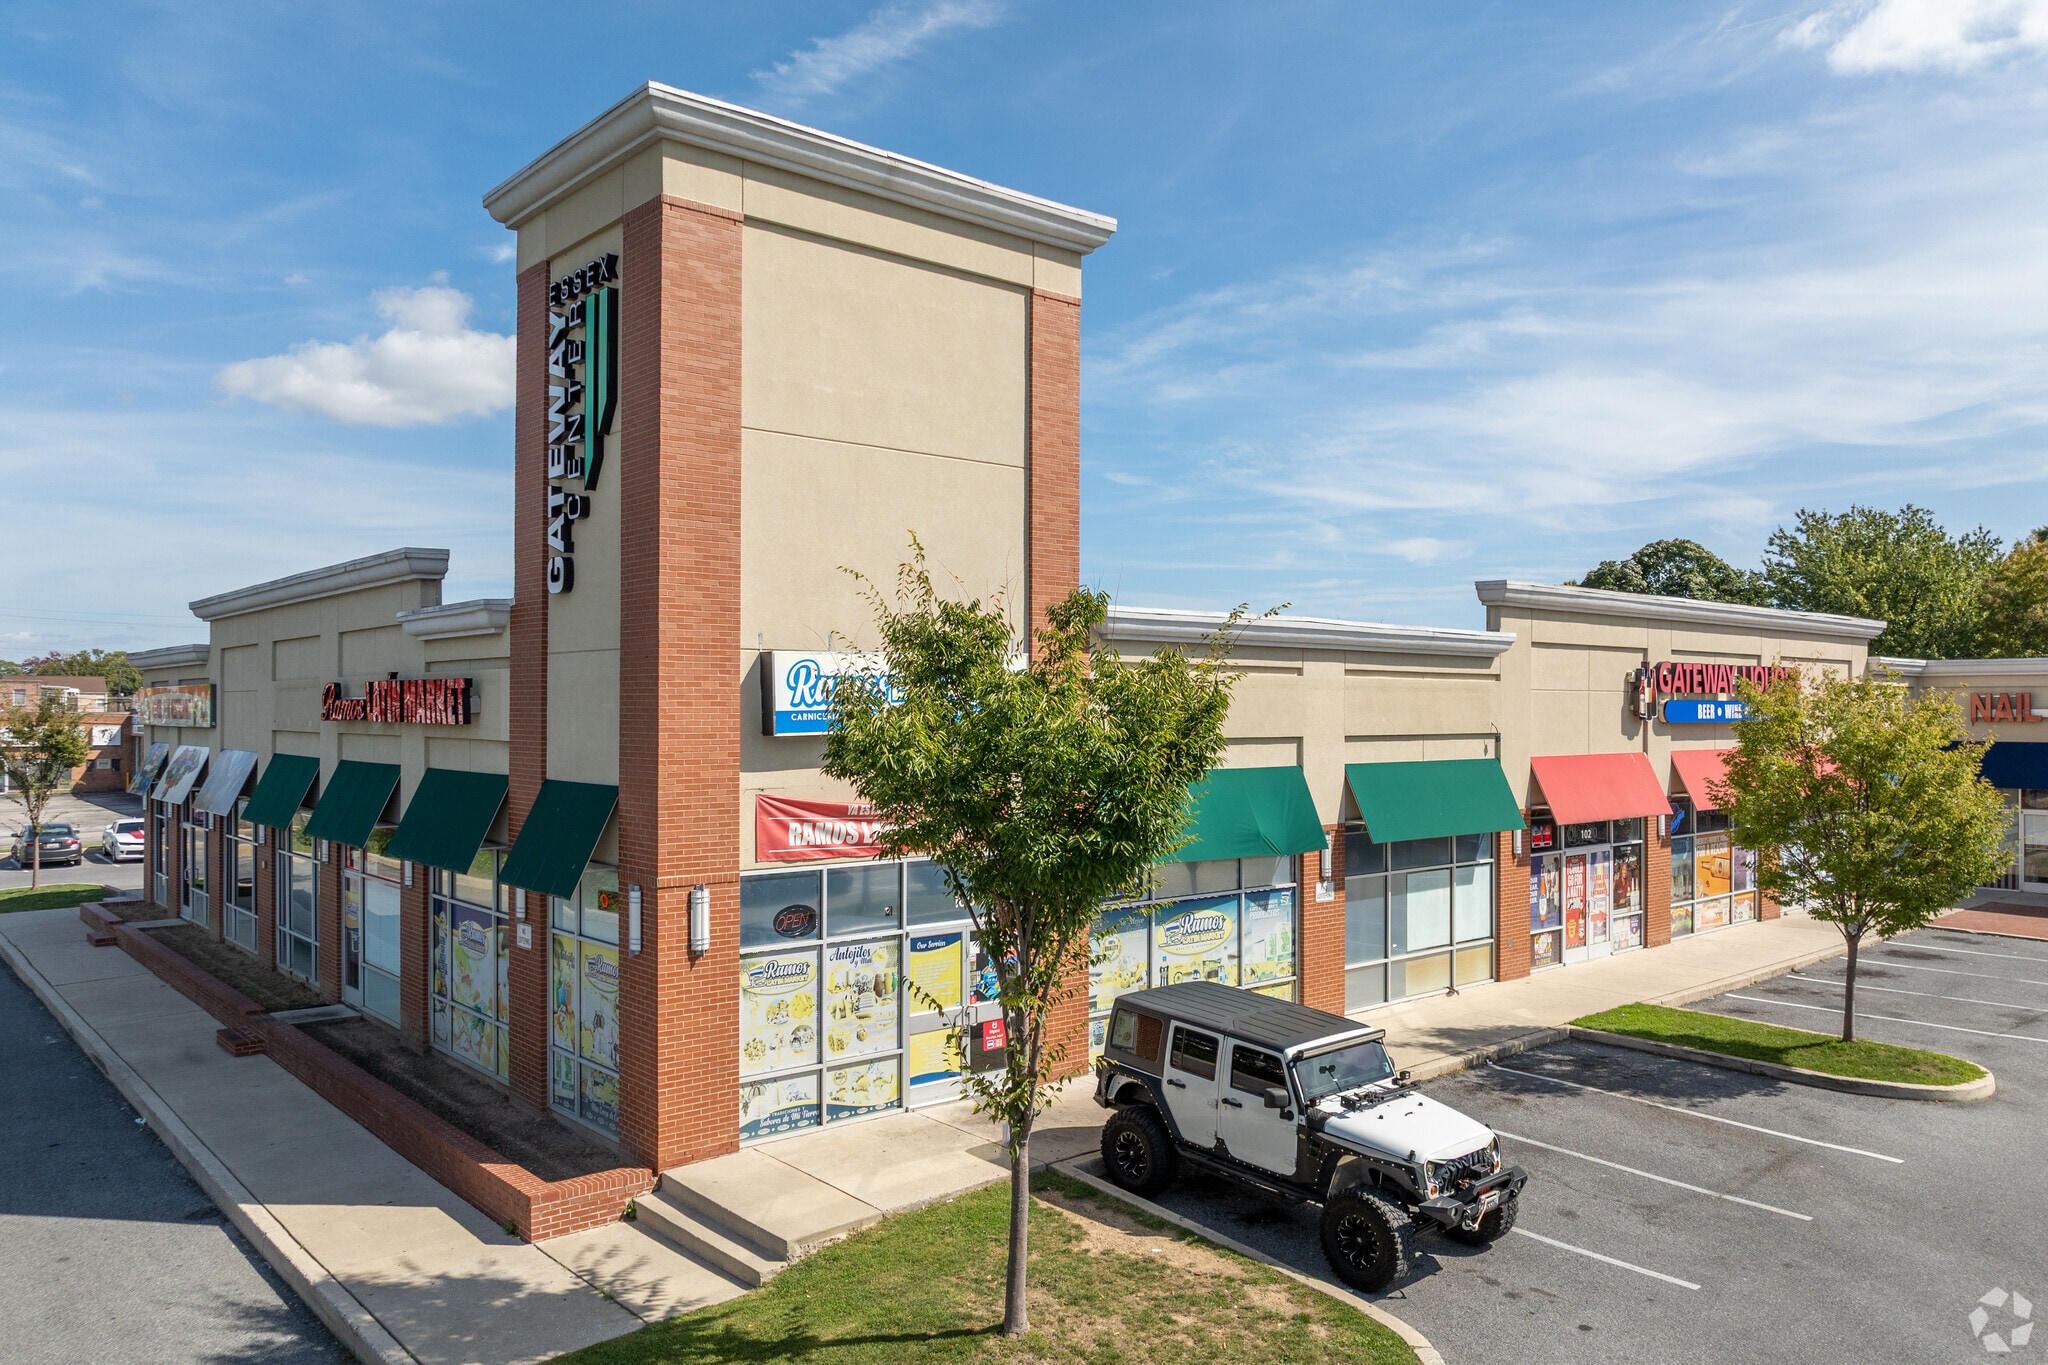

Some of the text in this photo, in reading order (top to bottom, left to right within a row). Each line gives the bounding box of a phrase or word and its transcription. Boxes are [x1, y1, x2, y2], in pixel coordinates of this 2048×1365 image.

[549, 254, 613, 306] ESSEX
[567, 299, 586, 520] CENTER
[547, 310, 569, 594] GATEWAY
[1659, 661, 1737, 694] GATEWAY
[321, 682, 365, 721] Ramos
[403, 678, 465, 725] MARKET
[1698, 704, 1716, 720] BEER
[1971, 692, 2043, 723] NAIL
[847, 805, 858, 816] YA
[788, 821, 860, 846] RAMOS
[1581, 829, 1592, 839] 102
[776, 912, 810, 931] OPEN
[1182, 914, 1226, 935] Ramos
[916, 941, 927, 950] Our
[765, 959, 810, 980] Ramos
